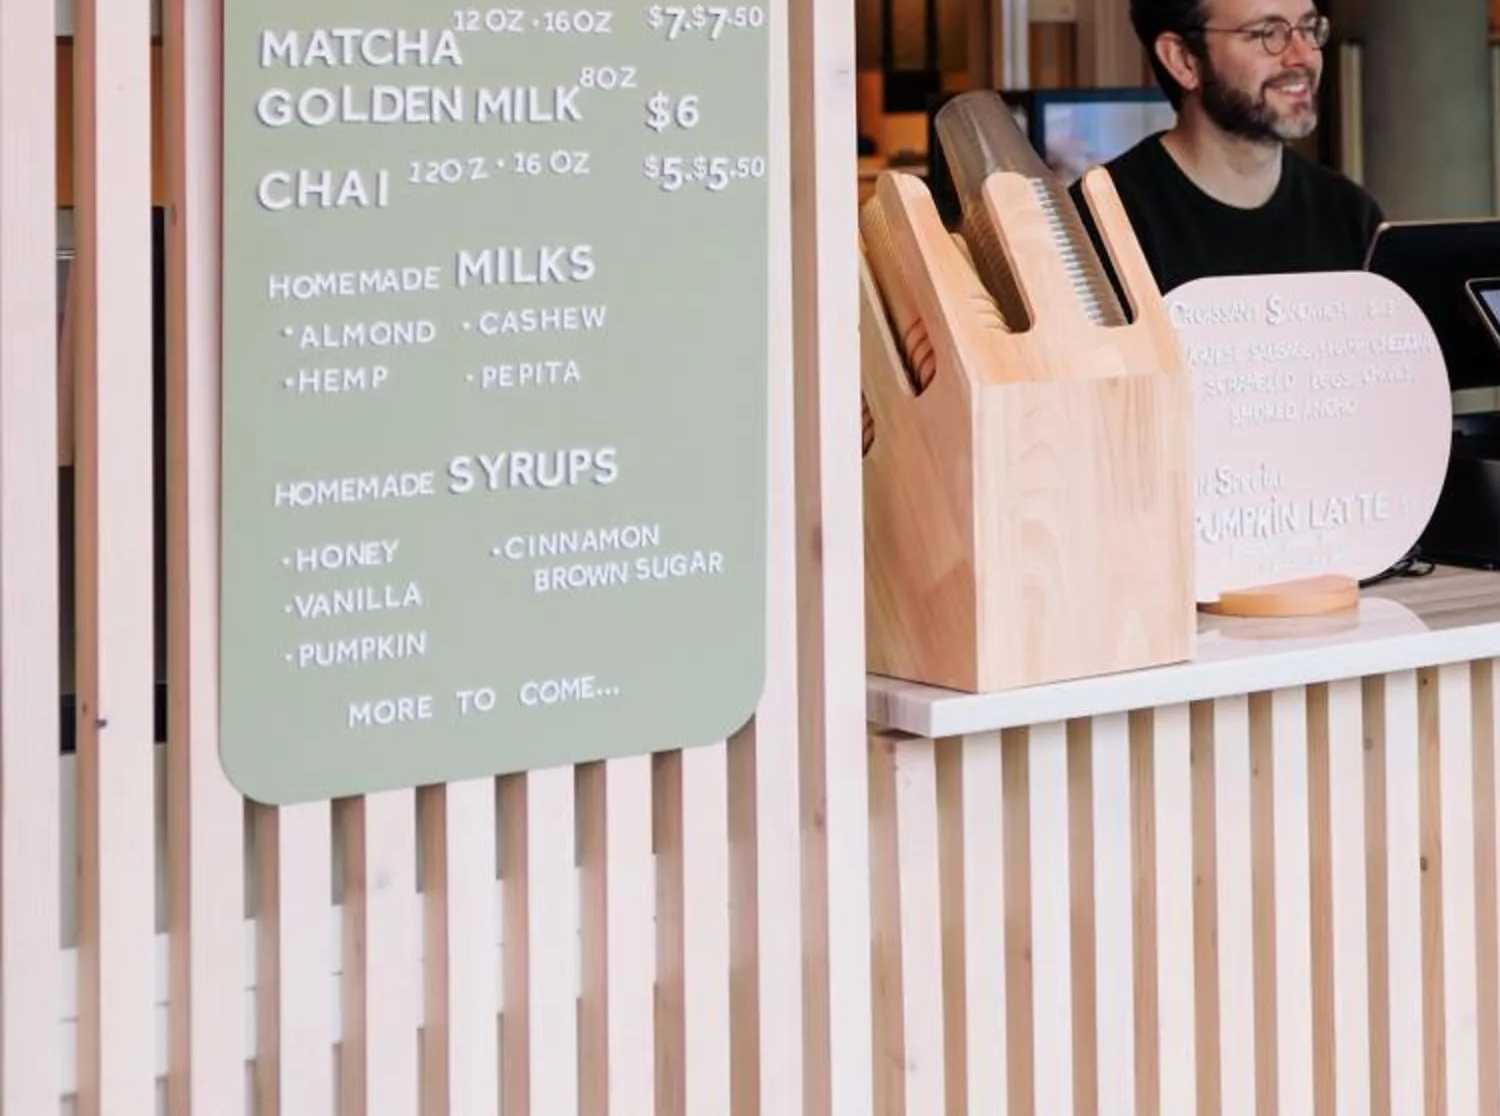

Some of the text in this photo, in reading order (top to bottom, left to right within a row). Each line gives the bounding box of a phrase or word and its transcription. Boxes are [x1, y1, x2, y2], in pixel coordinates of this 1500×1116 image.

[259, 28, 464, 68] MATCHA
[256, 86, 464, 128] GOLDEN
[473, 86, 584, 125] MILK
[645, 91, 700, 132] $6
[256, 168, 390, 211] CHAI
[268, 244, 597, 300] HOMEMADE MILKS
[299, 320, 436, 350] ALMOND
[479, 305, 607, 337] CASHEW
[297, 365, 390, 394] HEMP
[481, 359, 582, 389] PEPITA
[274, 446, 619, 508] HOMEMADE SYRUPS
[1307, 489, 1388, 530] LATTE
[295, 538, 400, 572] HONEY
[504, 524, 661, 561] CINNAMON
[534, 552, 725, 593] BROWN SUGAR
[294, 580, 423, 619] VANILLA
[298, 632, 428, 668] PUMPKIN
[347, 695, 434, 728] MORE
[455, 688, 497, 715] TO
